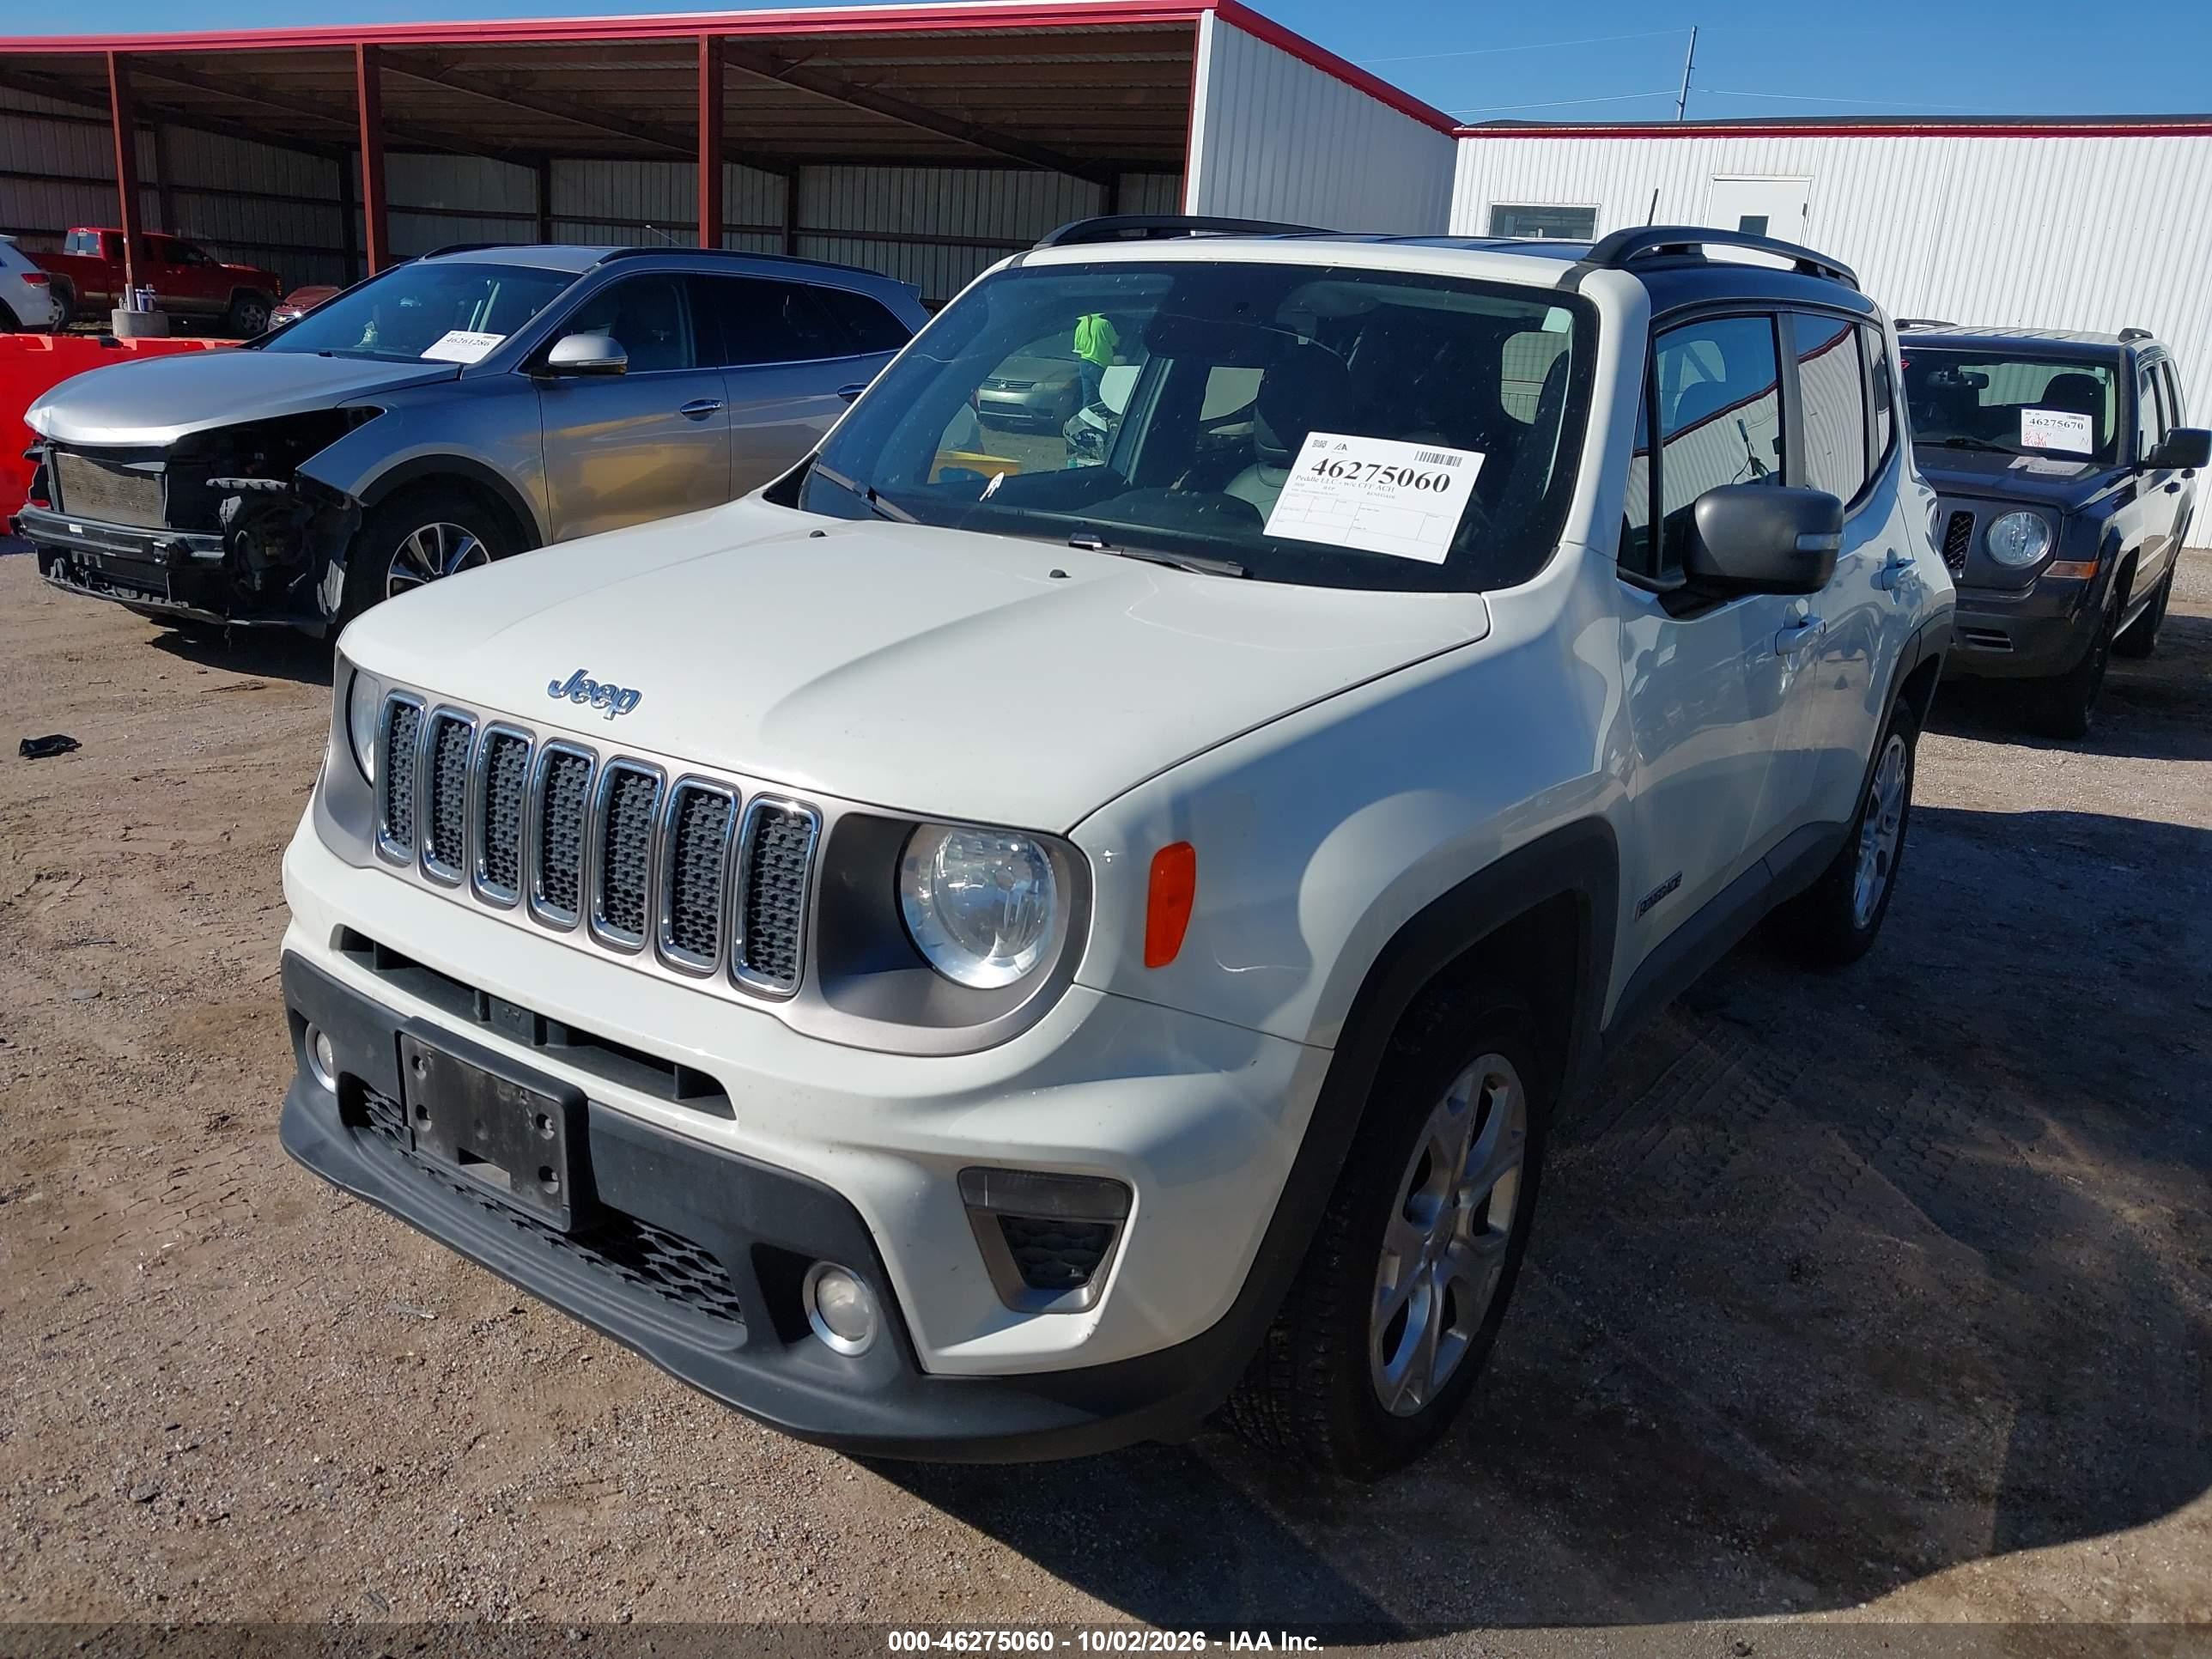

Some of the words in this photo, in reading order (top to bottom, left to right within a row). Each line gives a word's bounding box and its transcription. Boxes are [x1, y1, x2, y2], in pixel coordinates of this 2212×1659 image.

[2029, 418, 2084, 430] 46275670
[1296, 474, 1319, 483] Peddle
[1311, 458, 1450, 493] 46275060
[547, 668, 642, 720] Jeep
